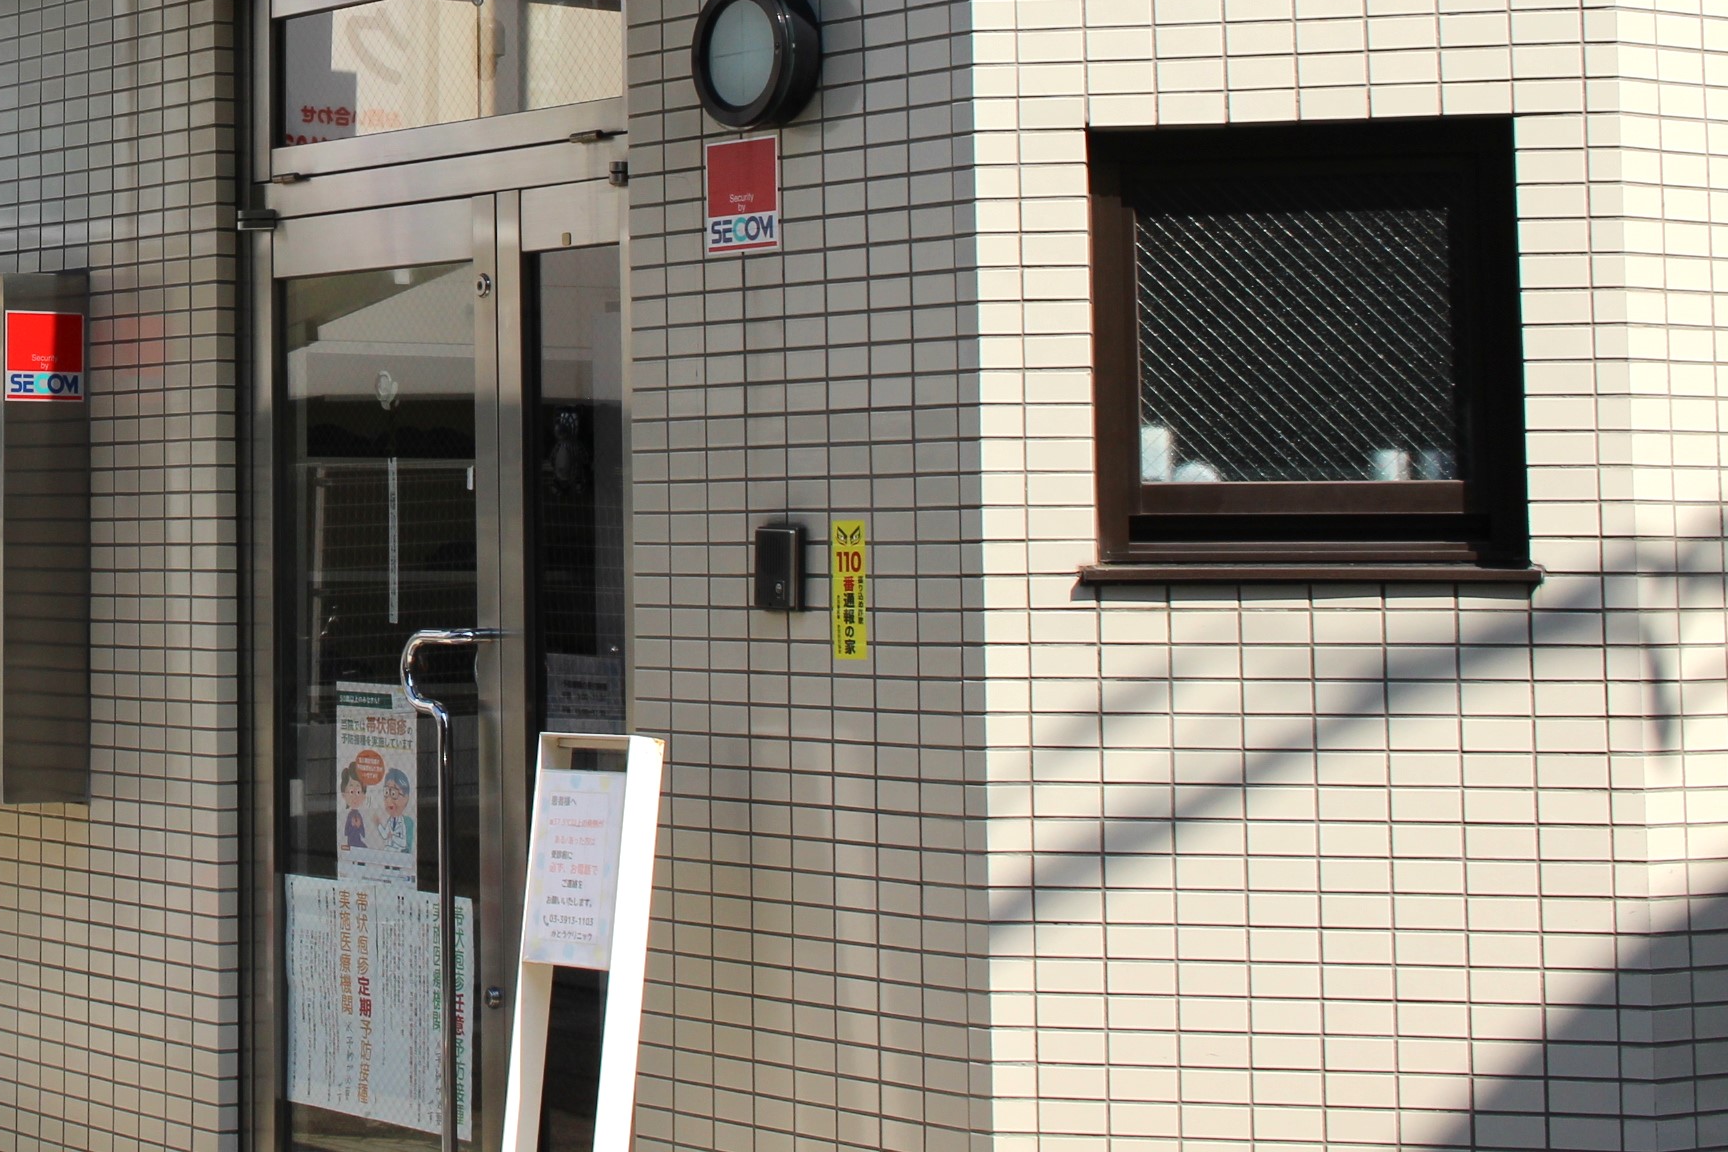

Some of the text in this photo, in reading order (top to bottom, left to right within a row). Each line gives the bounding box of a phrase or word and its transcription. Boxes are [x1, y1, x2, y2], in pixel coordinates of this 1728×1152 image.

[729, 193, 754, 203] Security
[737, 203, 746, 212] by
[711, 215, 774, 244] SECOM
[32, 354, 59, 362] Security
[40, 362, 49, 370] by
[10, 373, 79, 394] SECOM
[549, 914, 594, 926] 03-3913-1103
